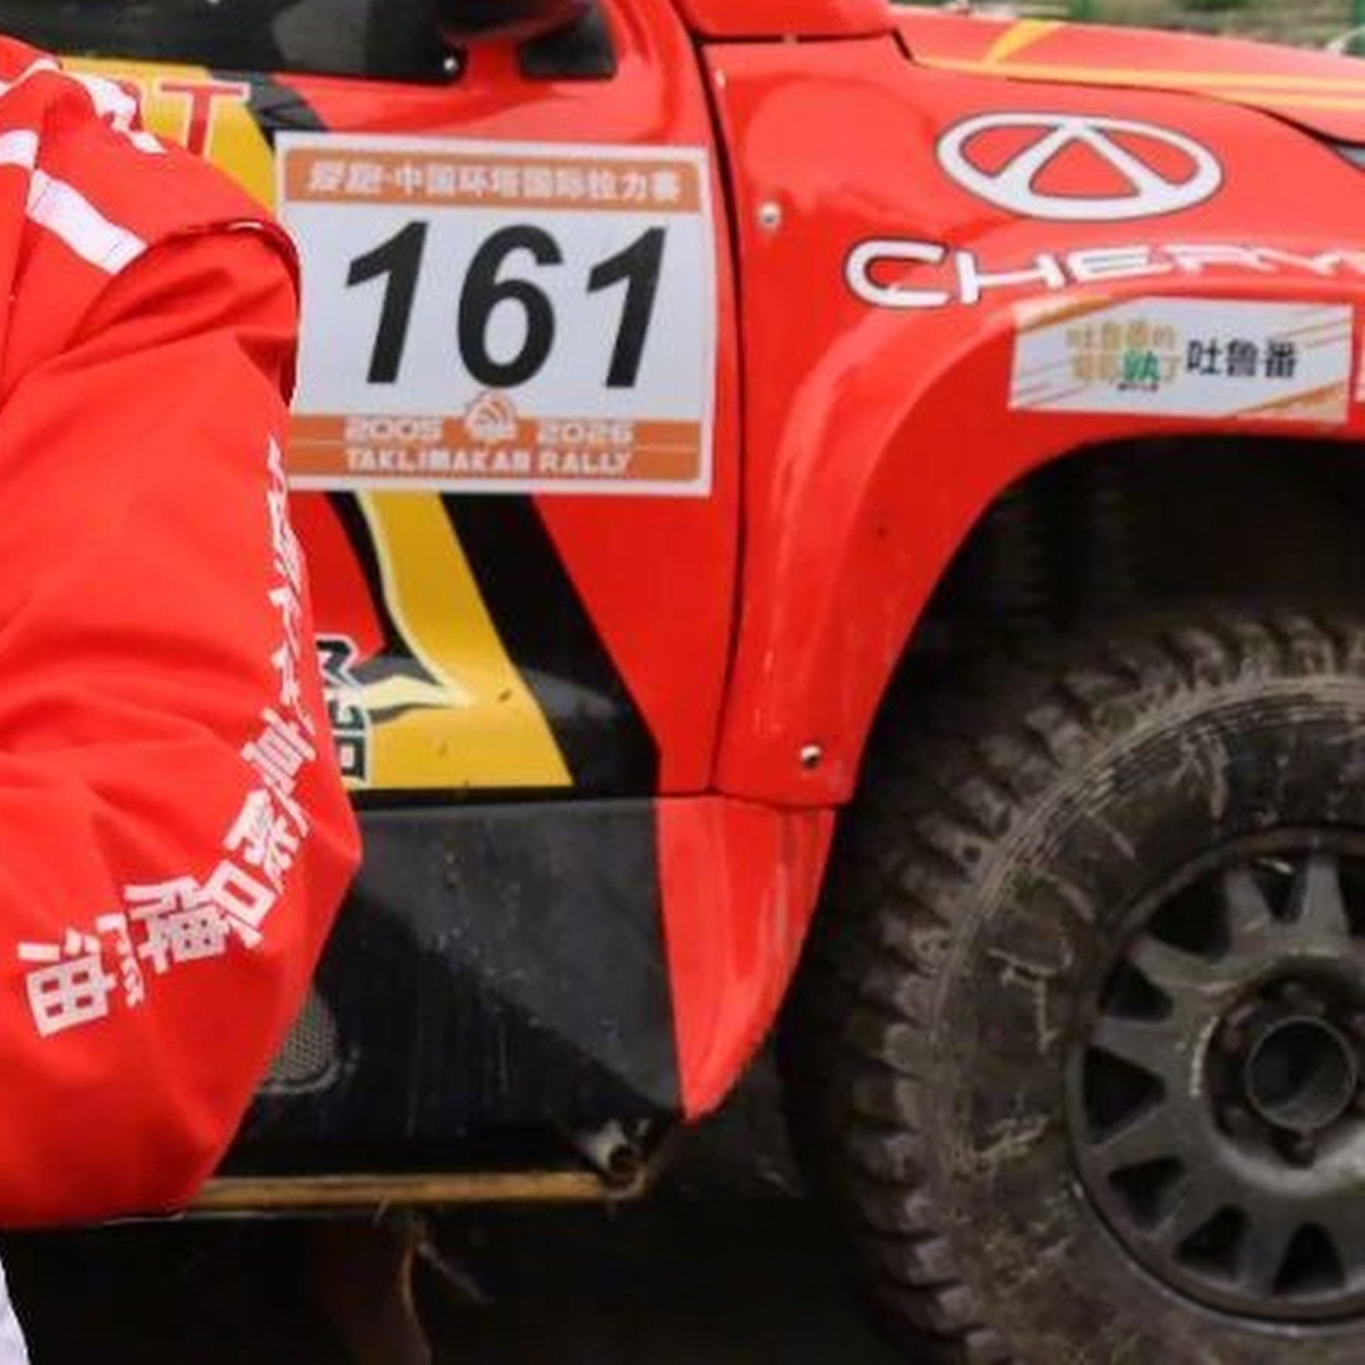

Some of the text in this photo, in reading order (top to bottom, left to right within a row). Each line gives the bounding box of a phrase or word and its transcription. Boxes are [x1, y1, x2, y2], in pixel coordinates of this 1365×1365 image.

[344, 221, 667, 388] 161
[1186, 338, 1297, 378] 吐鲁番
[538, 448, 633, 474] RALLY
